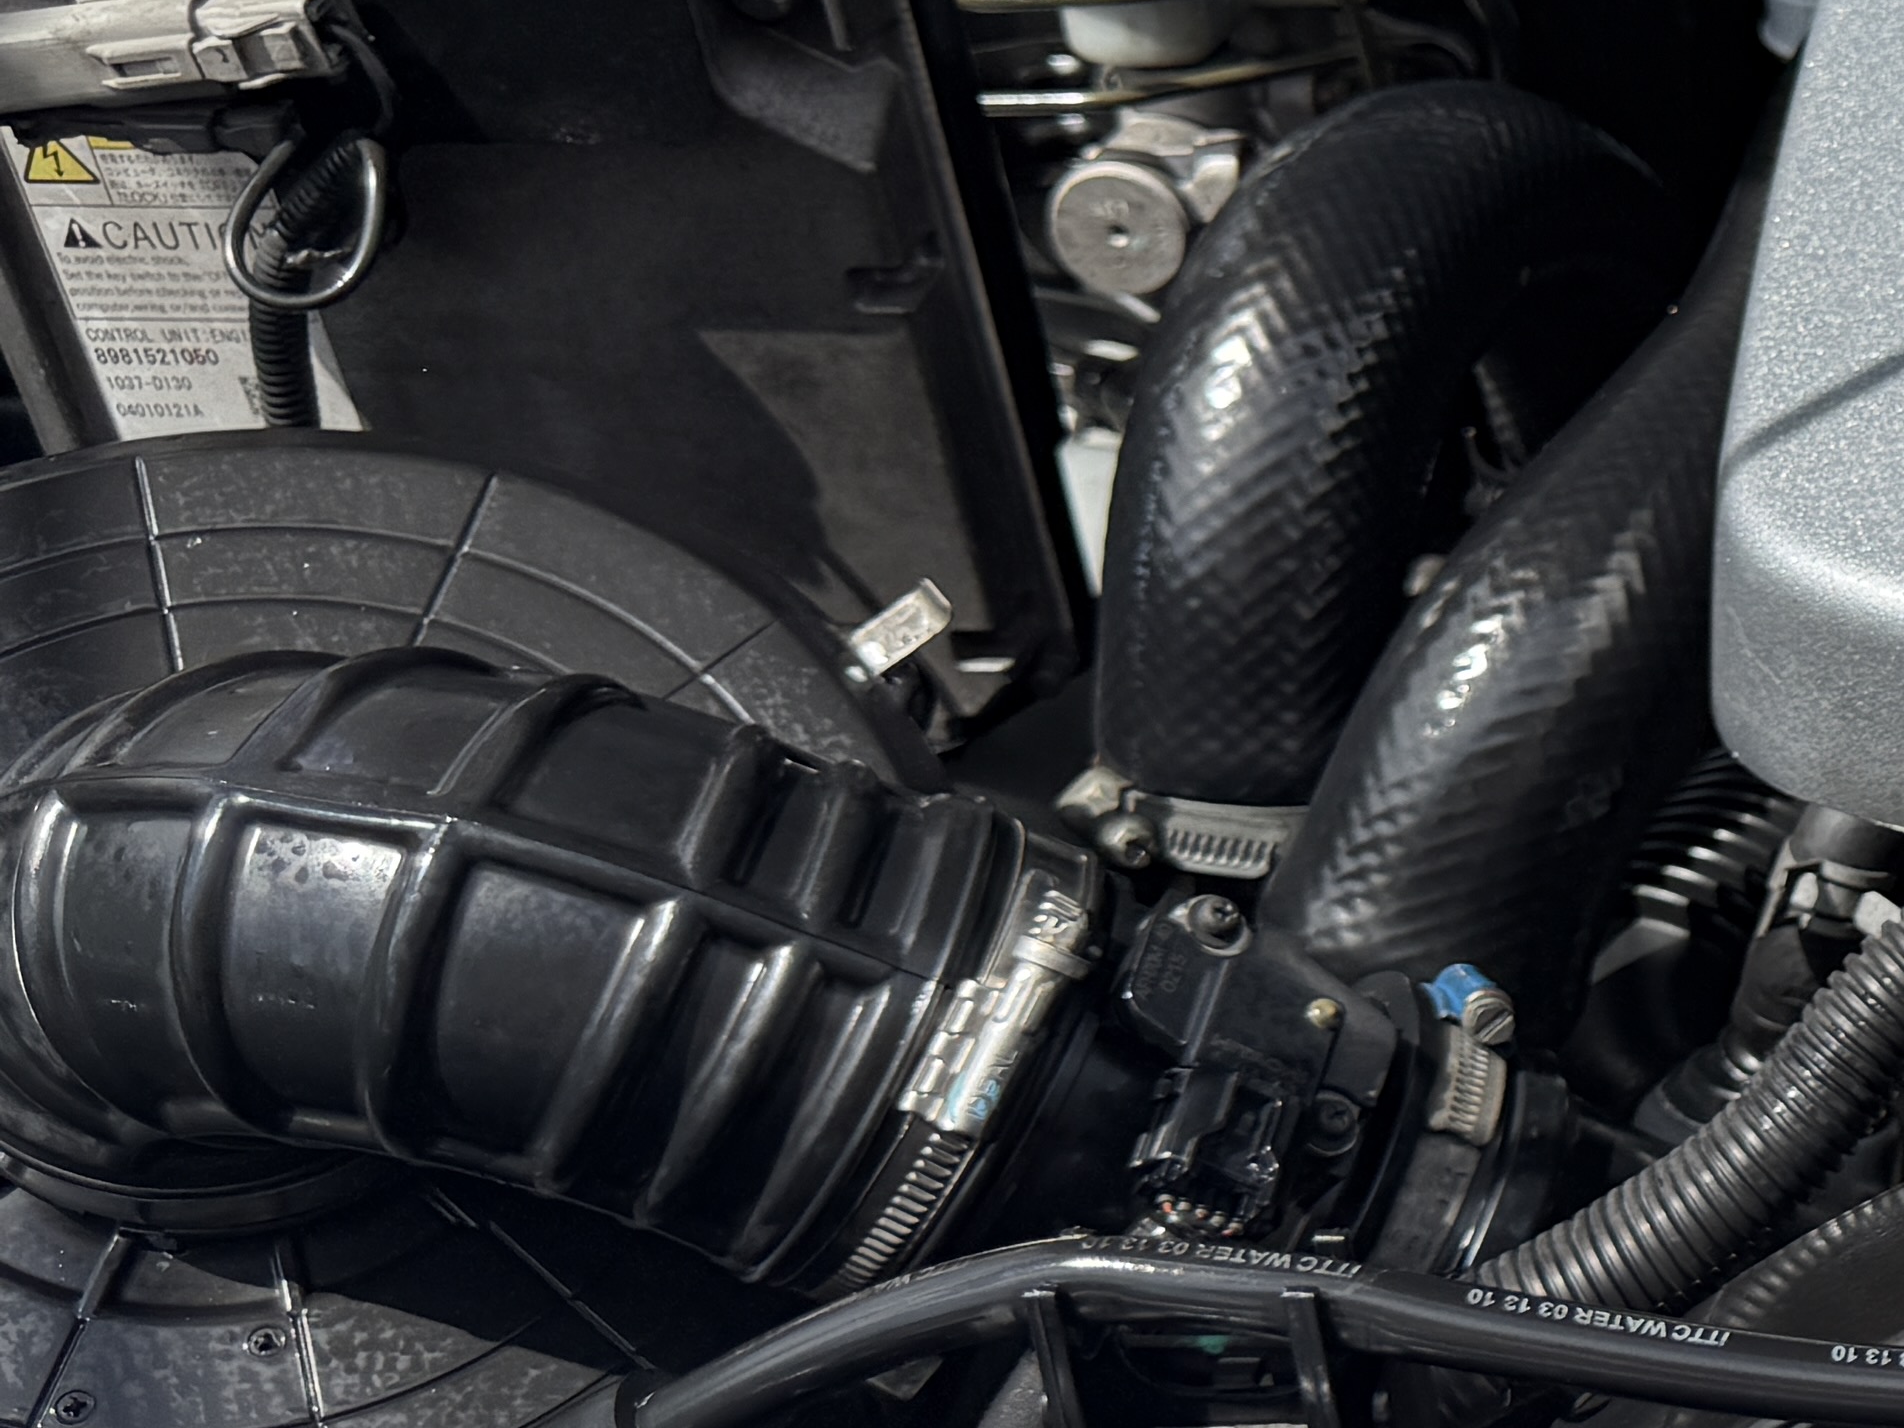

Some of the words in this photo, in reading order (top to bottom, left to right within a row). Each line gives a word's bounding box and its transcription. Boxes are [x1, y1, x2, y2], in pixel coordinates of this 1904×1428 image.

[85, 328, 154, 344] CONTROL
[1197, 1243, 1297, 1270] WATER
[1466, 1286, 1496, 1307] 10
[1538, 1300, 1568, 1322] 03
[1575, 1305, 1668, 1339] WATER
[1830, 1344, 1858, 1363] 10
[1864, 1347, 1891, 1366] 13
